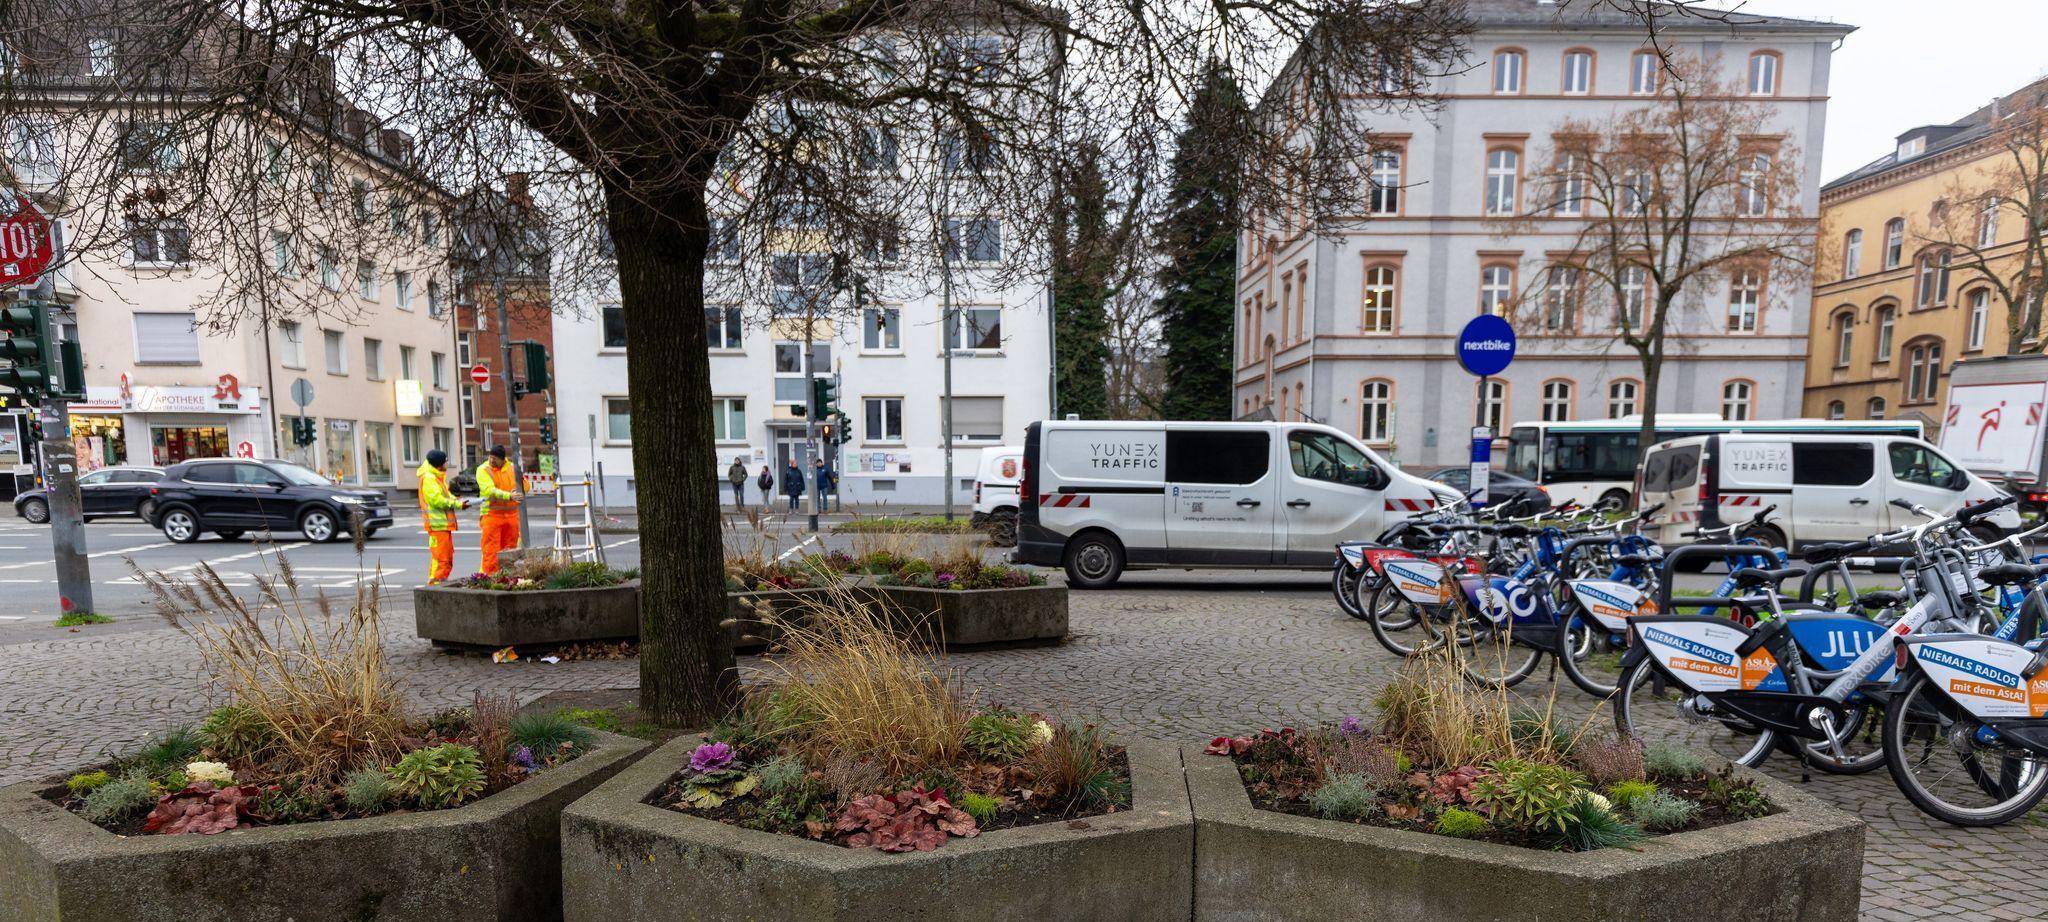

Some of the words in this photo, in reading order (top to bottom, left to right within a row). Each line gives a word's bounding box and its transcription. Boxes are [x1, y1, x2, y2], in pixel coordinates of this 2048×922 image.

[1463, 339, 1511, 351] nextbike
[155, 395, 205, 405] APOTHEKE
[1090, 443, 1158, 457] YUNEX
[1732, 449, 1787, 460] YUNEX
[1091, 458, 1158, 469] TRAFFIC
[1734, 463, 1788, 472] TRAFFIC
[1388, 565, 1414, 579] NIEMALS
[1577, 584, 1607, 600] NIEMALS
[1606, 596, 1633, 611] RADLOS
[1999, 617, 2019, 640] 91283
[1647, 630, 1691, 650] NIEMALS
[1691, 644, 1731, 664] RADLOS
[1821, 630, 1875, 658] JLU
[1671, 659, 1688, 668] mit
[1689, 660, 1710, 672] dem
[1711, 666, 1737, 677] AStA!
[1834, 646, 1892, 699] nextbike
[1921, 648, 1973, 671] NIEMALS
[1974, 664, 2016, 686] RADLOS
[1953, 682, 1971, 692] mit
[1973, 684, 1995, 696] dem
[1997, 690, 2023, 701] AStA!
